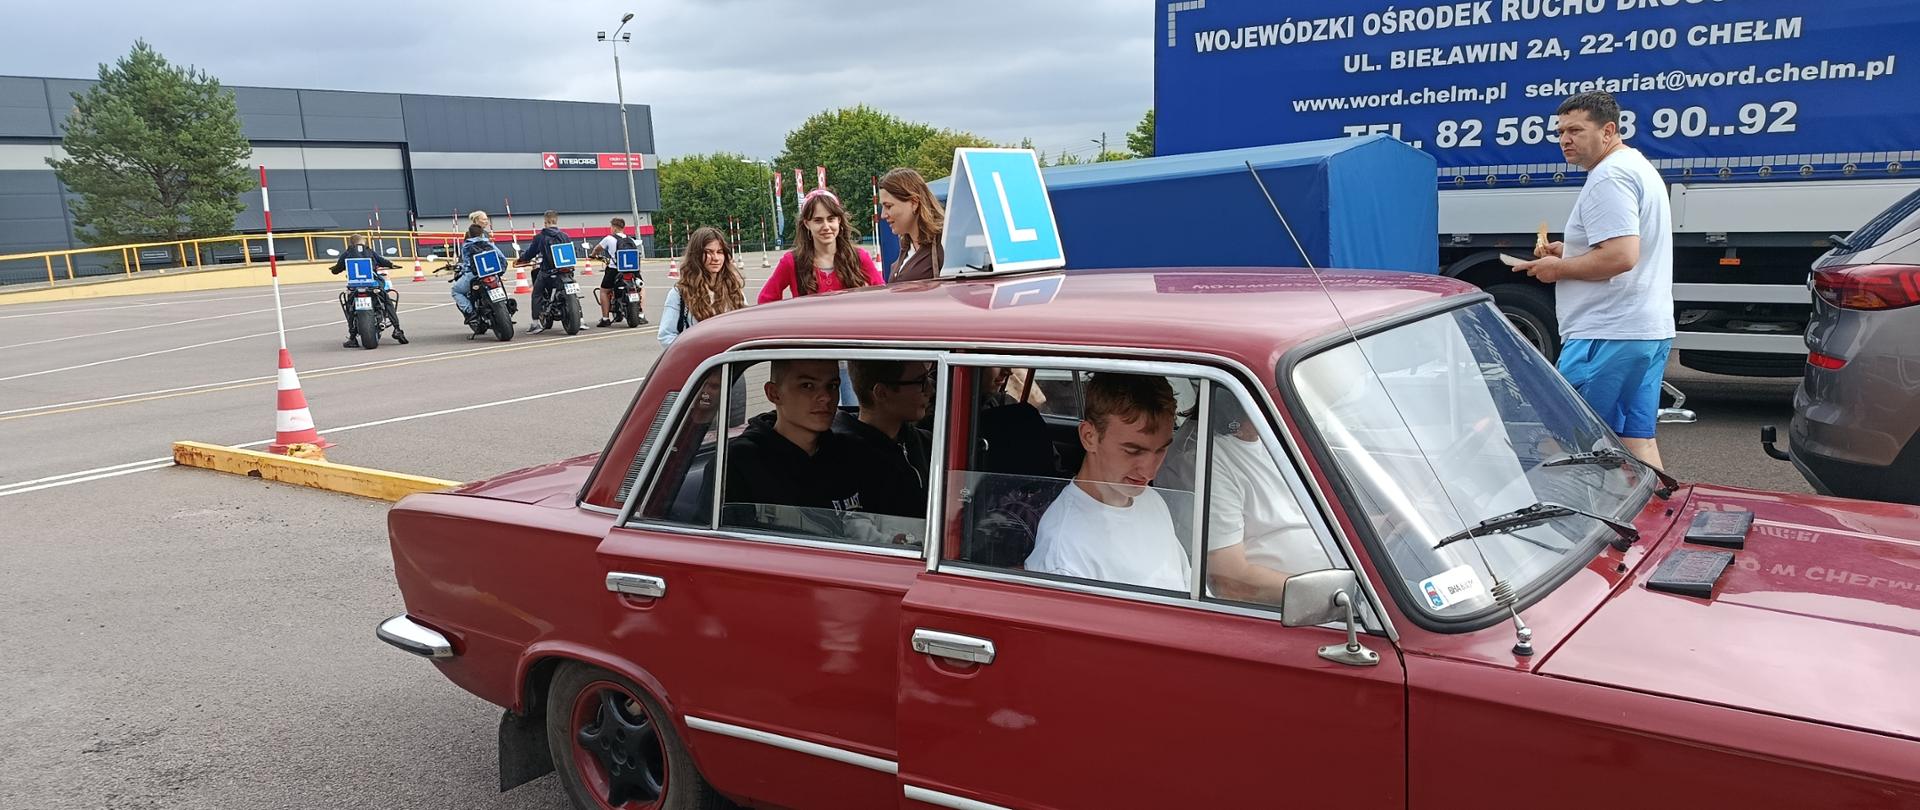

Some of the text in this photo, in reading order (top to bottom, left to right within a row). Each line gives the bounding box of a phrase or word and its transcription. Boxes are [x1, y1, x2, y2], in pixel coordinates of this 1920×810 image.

[1195, 15, 1354, 52] WOJEWÓDZKI
[1363, 0, 1493, 36] OŚRODEK
[1344, 17, 1801, 73] UL. BIEŁAWIN 2A, 22-100 CHEŁM
[1293, 55, 1895, 112] www.word.chelm.pl sekretariat@word.chelm.pl
[1436, 119, 1483, 148] 82
[1652, 101, 1797, 139] 90..92
[991, 171, 1038, 243] L
[354, 262, 367, 278] L
[481, 257, 495, 273] L
[559, 249, 571, 263] L
[623, 254, 633, 268] L
